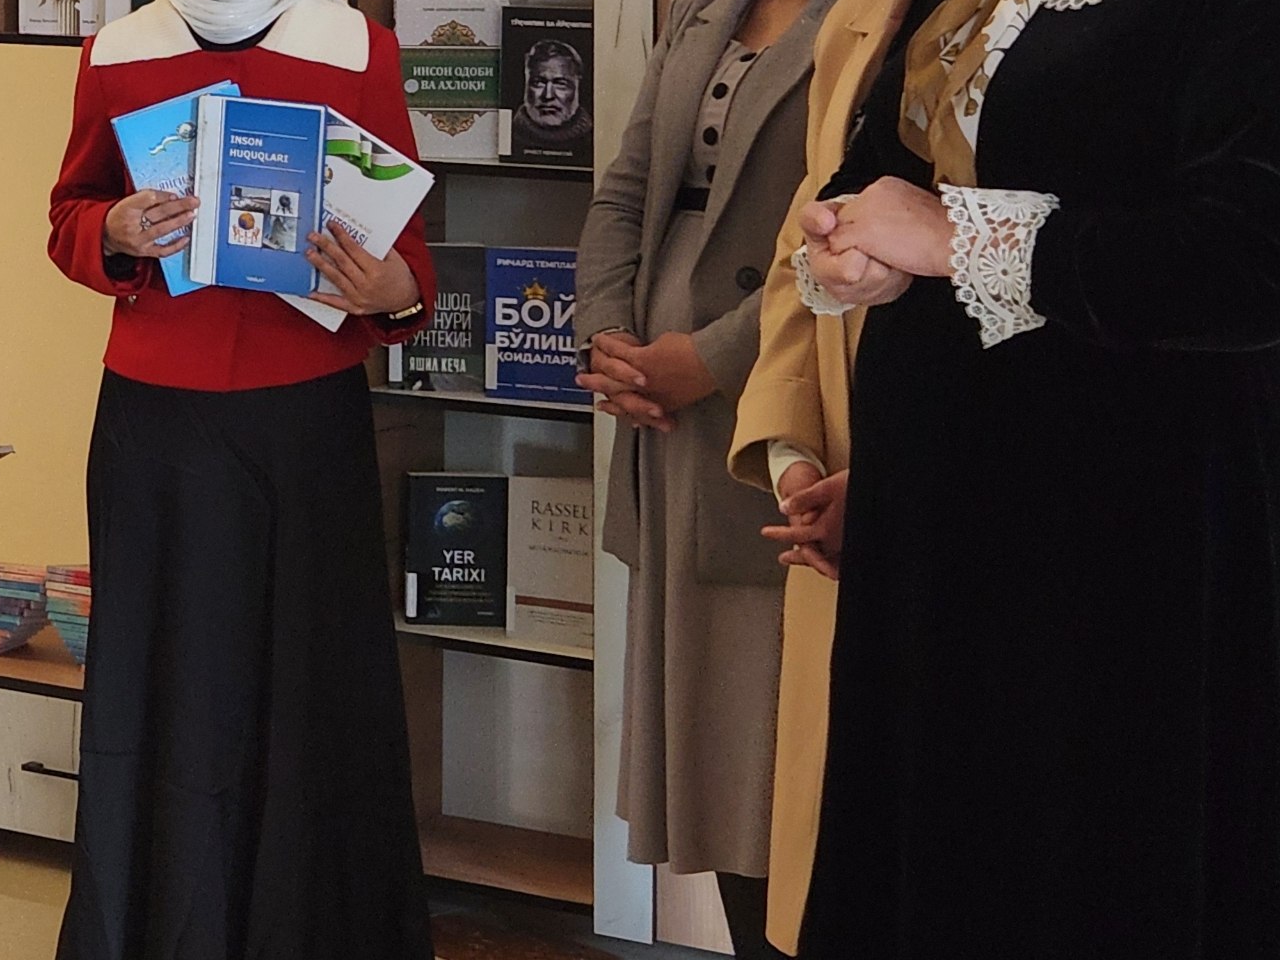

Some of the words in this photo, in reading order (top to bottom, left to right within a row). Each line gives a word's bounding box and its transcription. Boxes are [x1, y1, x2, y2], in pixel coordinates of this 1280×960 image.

[413, 66, 453, 77] ИНСОН
[454, 66, 494, 79] ОДОБИ
[420, 80, 437, 90] ВА
[230, 135, 263, 147] INSON
[229, 148, 289, 163] HUQUQLARI
[496, 258, 535, 268] РИЧАРД
[434, 292, 471, 312] ШОД
[495, 293, 577, 329] БОЙ
[434, 311, 472, 330] НУРИ
[495, 327, 578, 352] БЎЛИШ
[409, 356, 439, 372] ЯШИЛ
[440, 357, 467, 373] КЕЧА
[531, 500, 590, 519] RASSEL
[442, 549, 475, 565] YER
[431, 566, 486, 582] TARIXI
